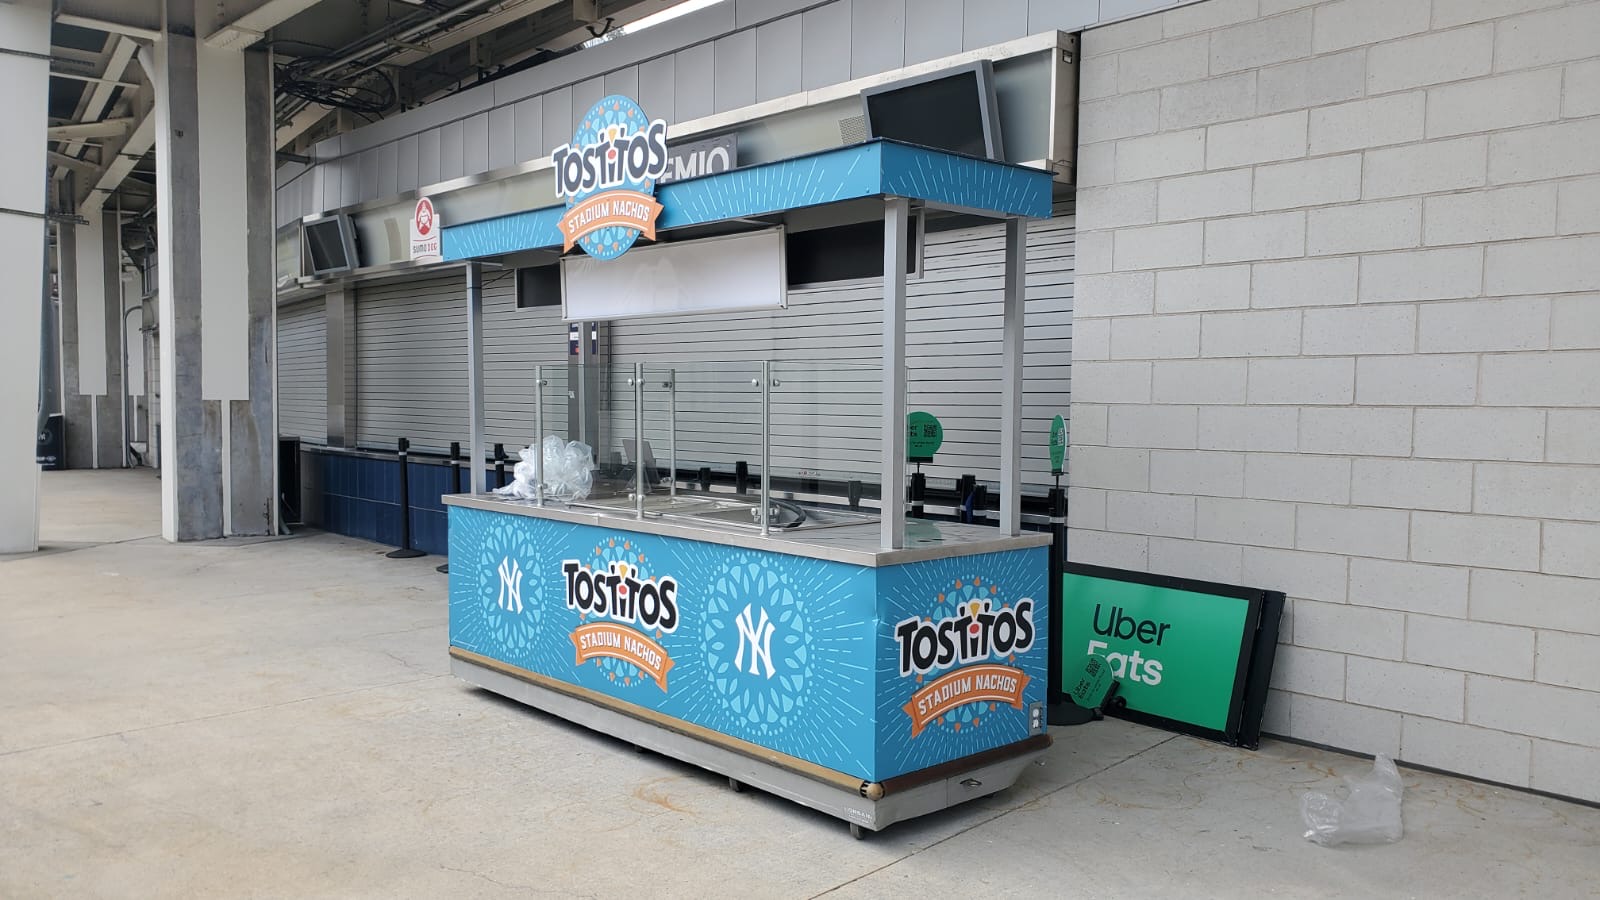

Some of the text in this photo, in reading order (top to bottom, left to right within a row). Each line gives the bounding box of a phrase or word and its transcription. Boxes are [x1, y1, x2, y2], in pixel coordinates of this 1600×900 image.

[568, 200, 651, 234] STADIUM NACHOS
[1093, 603, 1171, 646] Uber
[580, 634, 662, 671] STADIUM NACHOS
[918, 674, 1017, 715] STADIUM NACHOS
